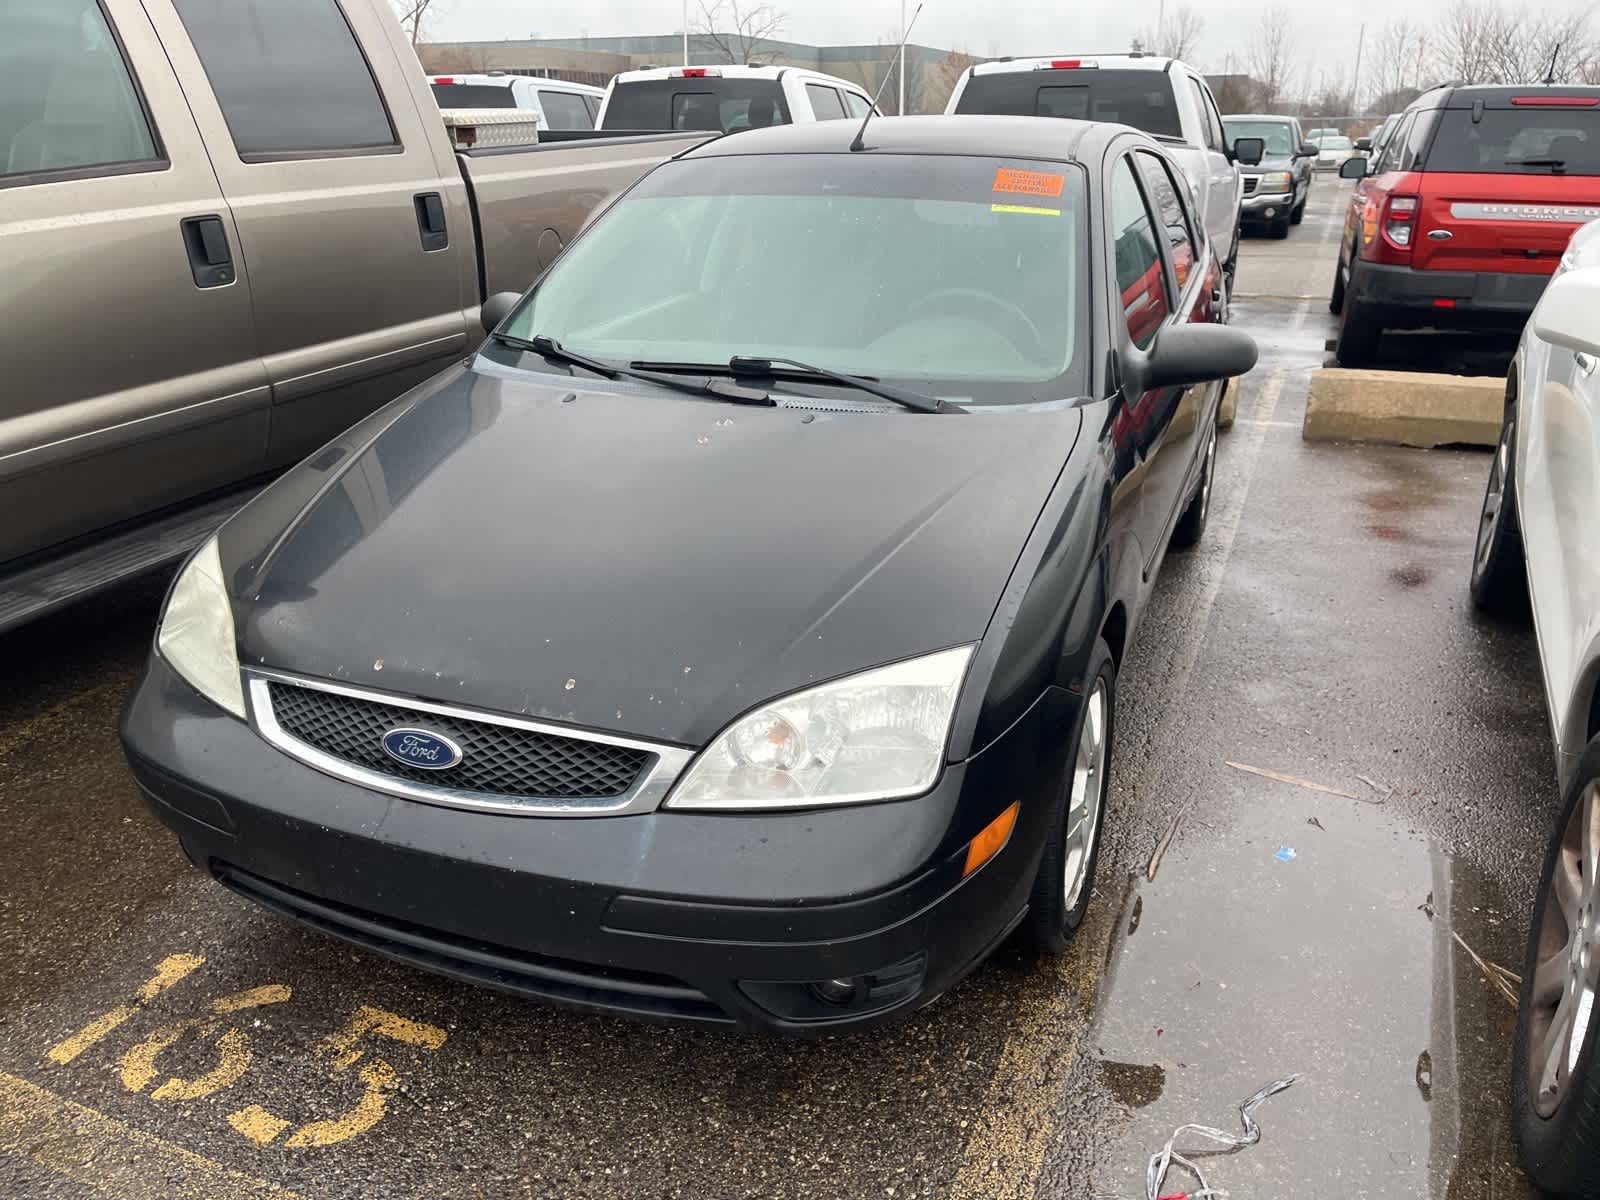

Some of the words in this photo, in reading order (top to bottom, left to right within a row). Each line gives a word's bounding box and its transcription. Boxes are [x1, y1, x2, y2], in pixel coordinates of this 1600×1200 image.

[1482, 205, 1599, 216] BRONCO
[399, 735, 440, 761] Ford
[46, 952, 448, 1149] 165
